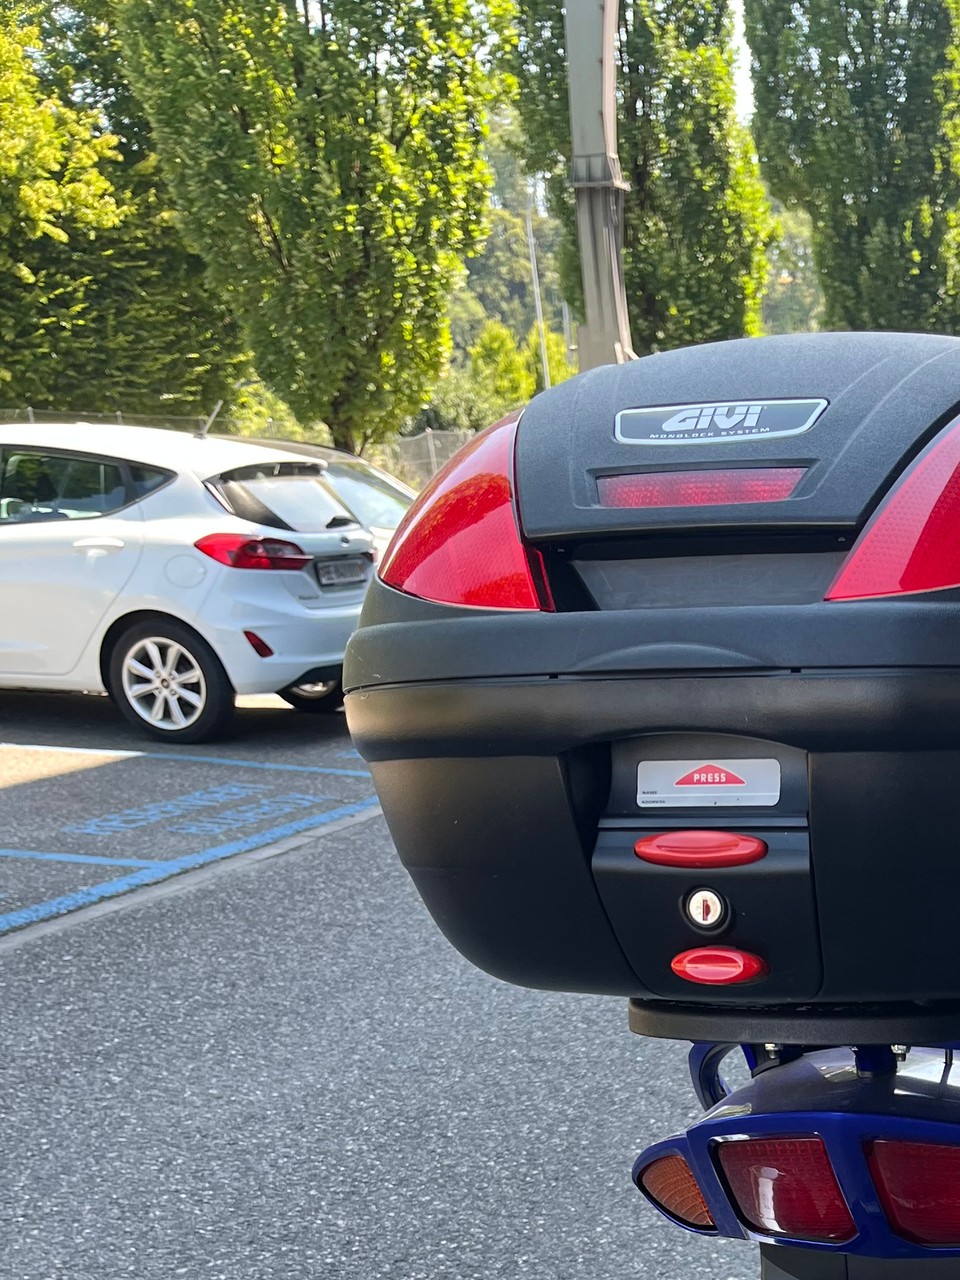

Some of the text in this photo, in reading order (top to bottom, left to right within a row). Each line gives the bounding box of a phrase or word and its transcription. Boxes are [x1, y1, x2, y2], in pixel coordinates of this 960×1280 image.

[662, 405, 763, 431] GIVI
[721, 427, 770, 436] SYSTEM
[693, 773, 726, 783] PRESS
